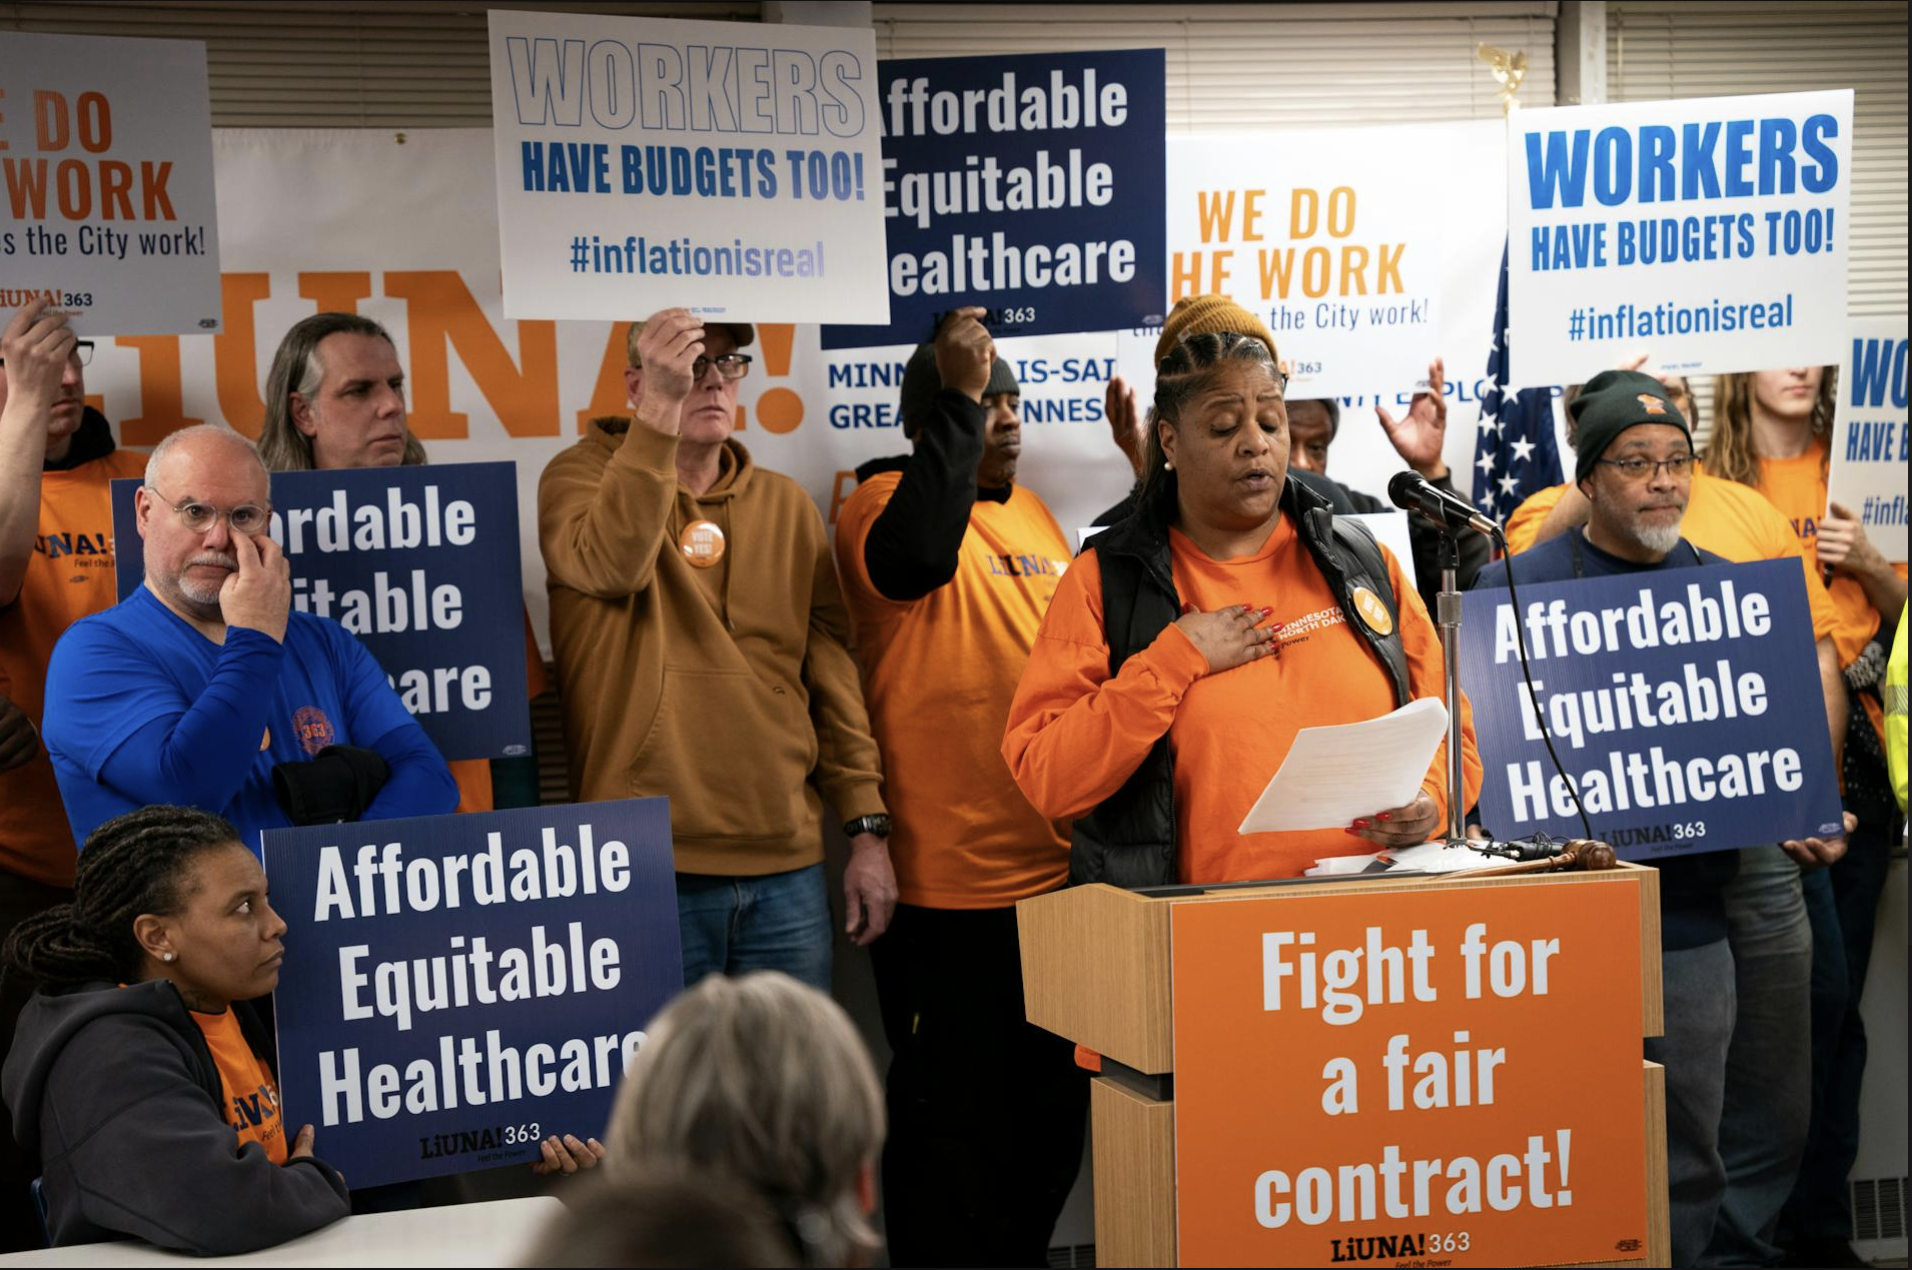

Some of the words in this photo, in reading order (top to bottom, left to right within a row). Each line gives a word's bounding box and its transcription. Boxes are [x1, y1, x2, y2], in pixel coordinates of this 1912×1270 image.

[507, 37, 865, 138] WORKERS
[877, 68, 1128, 138] ffordable
[34, 89, 112, 154] DO
[3, 157, 178, 221] WORK
[521, 141, 610, 194] HAVE
[621, 145, 778, 200] BUDGETS
[786, 150, 866, 201] TOO!
[1524, 114, 1839, 210] WORKERS
[26, 225, 68, 255] the
[78, 225, 128, 260] City
[139, 226, 206, 256] work!
[1198, 189, 1266, 244] WE
[1289, 186, 1357, 241] DO
[1531, 223, 1607, 272] HAVE
[1617, 213, 1755, 266] BUDGETS
[1764, 208, 1835, 256] TOO!
[569, 235, 825, 280] #inflationisreal
[890, 232, 1136, 297] ealthcare
[1171, 250, 1235, 304] HE
[1258, 243, 1407, 301] WORK
[64, 293, 93, 307] 363
[1004, 307, 1036, 324] 363
[1270, 305, 1306, 331] the
[1315, 302, 1360, 331] City
[1369, 298, 1429, 326] work!
[1568, 294, 1793, 342] #inflationisreal
[1297, 362, 1323, 375] 363
[1845, 422, 1895, 461] HAVE
[1320, 613, 1347, 628] DAK
[1494, 580, 1772, 664] Affordable
[1516, 660, 1768, 748] Equitable
[1507, 746, 1802, 822] Healthcare
[1673, 821, 1706, 840] 363
[313, 823, 631, 922] Affordable
[338, 922, 621, 1031] Equitable
[1262, 926, 1437, 1026] Fight
[1460, 922, 1560, 999] for
[1321, 1056, 1359, 1116] a
[1382, 1030, 1506, 1112] fair
[420, 1127, 503, 1160] LiUNA!
[504, 1122, 541, 1145] 363
[1254, 1128, 1573, 1229] contract!
[1331, 1233, 1425, 1262] LiUNA!
[1428, 1231, 1471, 1254] 363
[1426, 1259, 1452, 1268] Power
